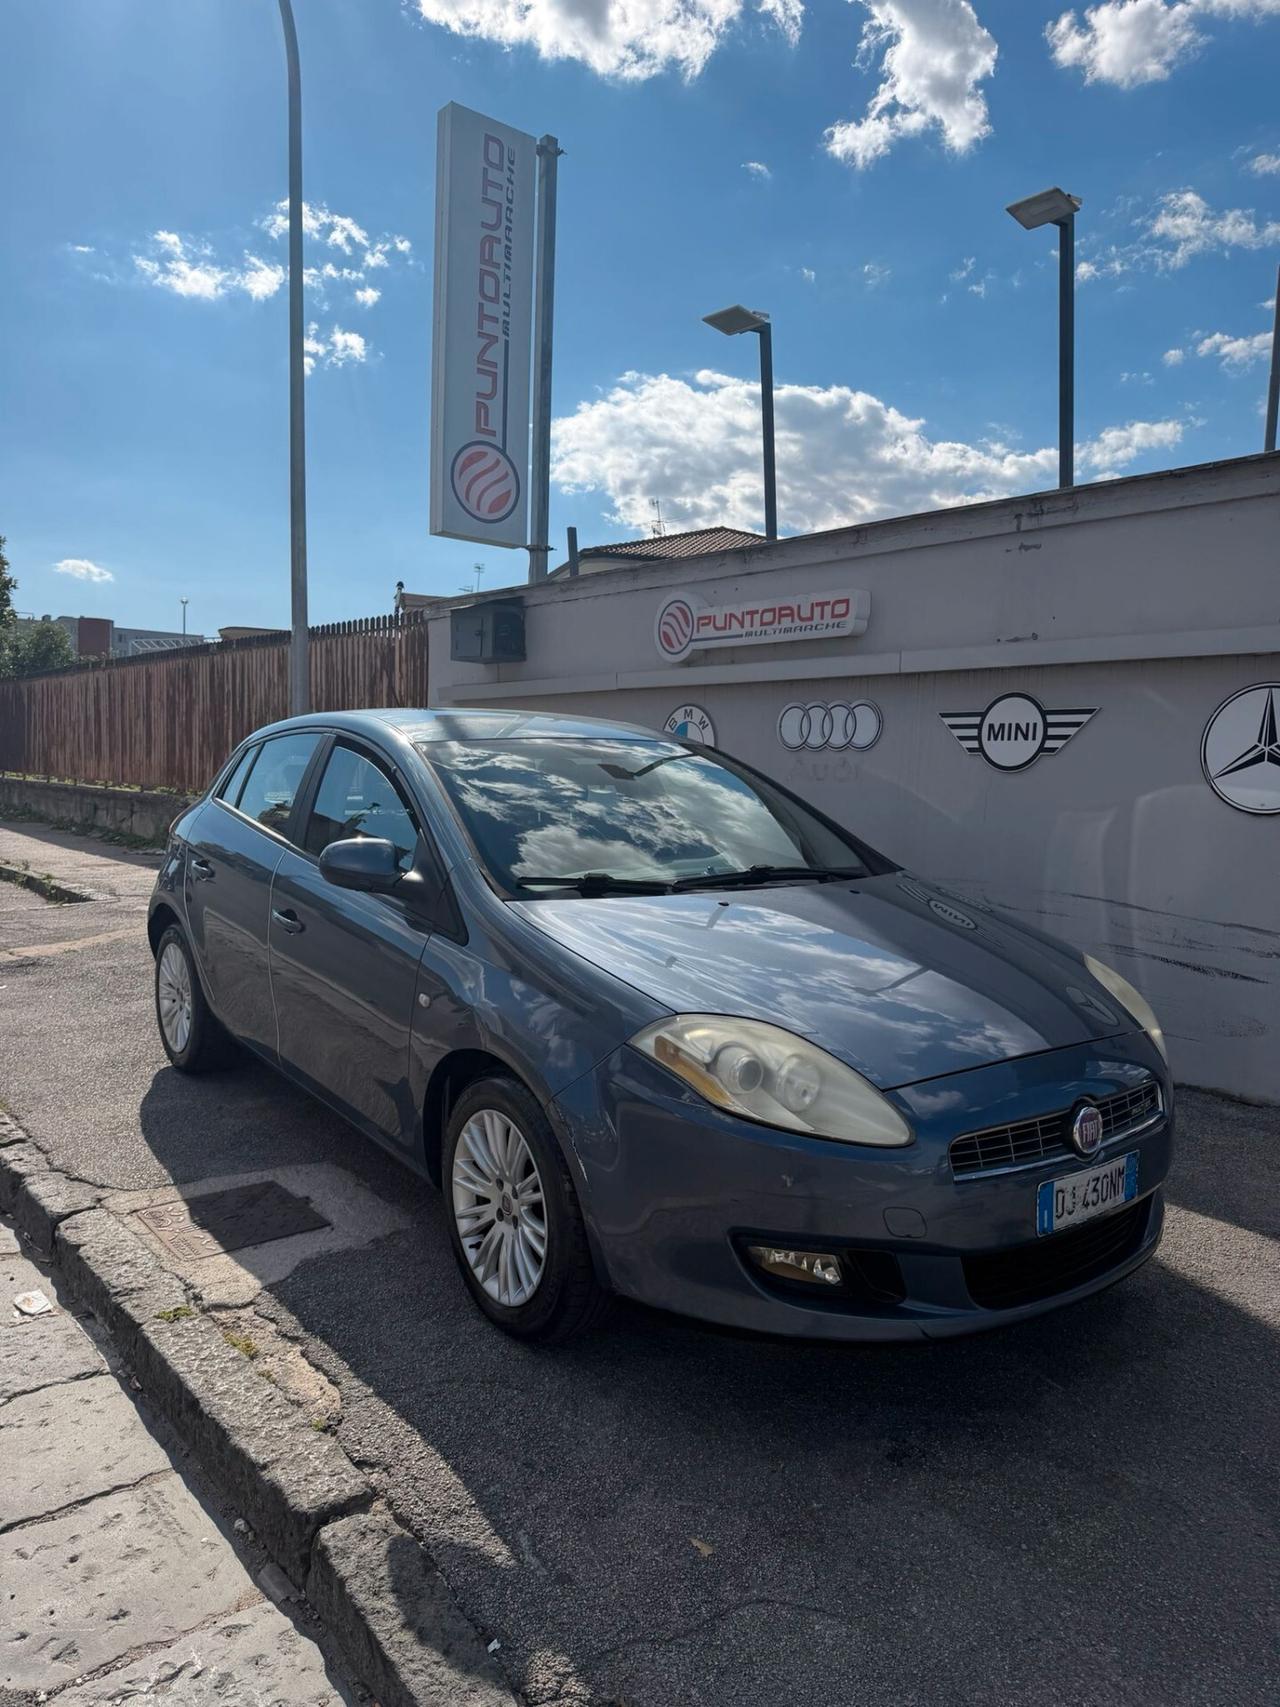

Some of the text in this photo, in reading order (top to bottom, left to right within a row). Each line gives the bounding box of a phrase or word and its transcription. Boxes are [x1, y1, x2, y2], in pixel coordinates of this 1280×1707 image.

[502, 144, 516, 338] MULTIMARCHE
[475, 132, 505, 438] PUNTOAUTO
[696, 598, 850, 634] PUNTOAUTO
[744, 621, 848, 639] MULTIMARCHE
[668, 708, 710, 731] BMW
[987, 722, 1038, 742] MINI
